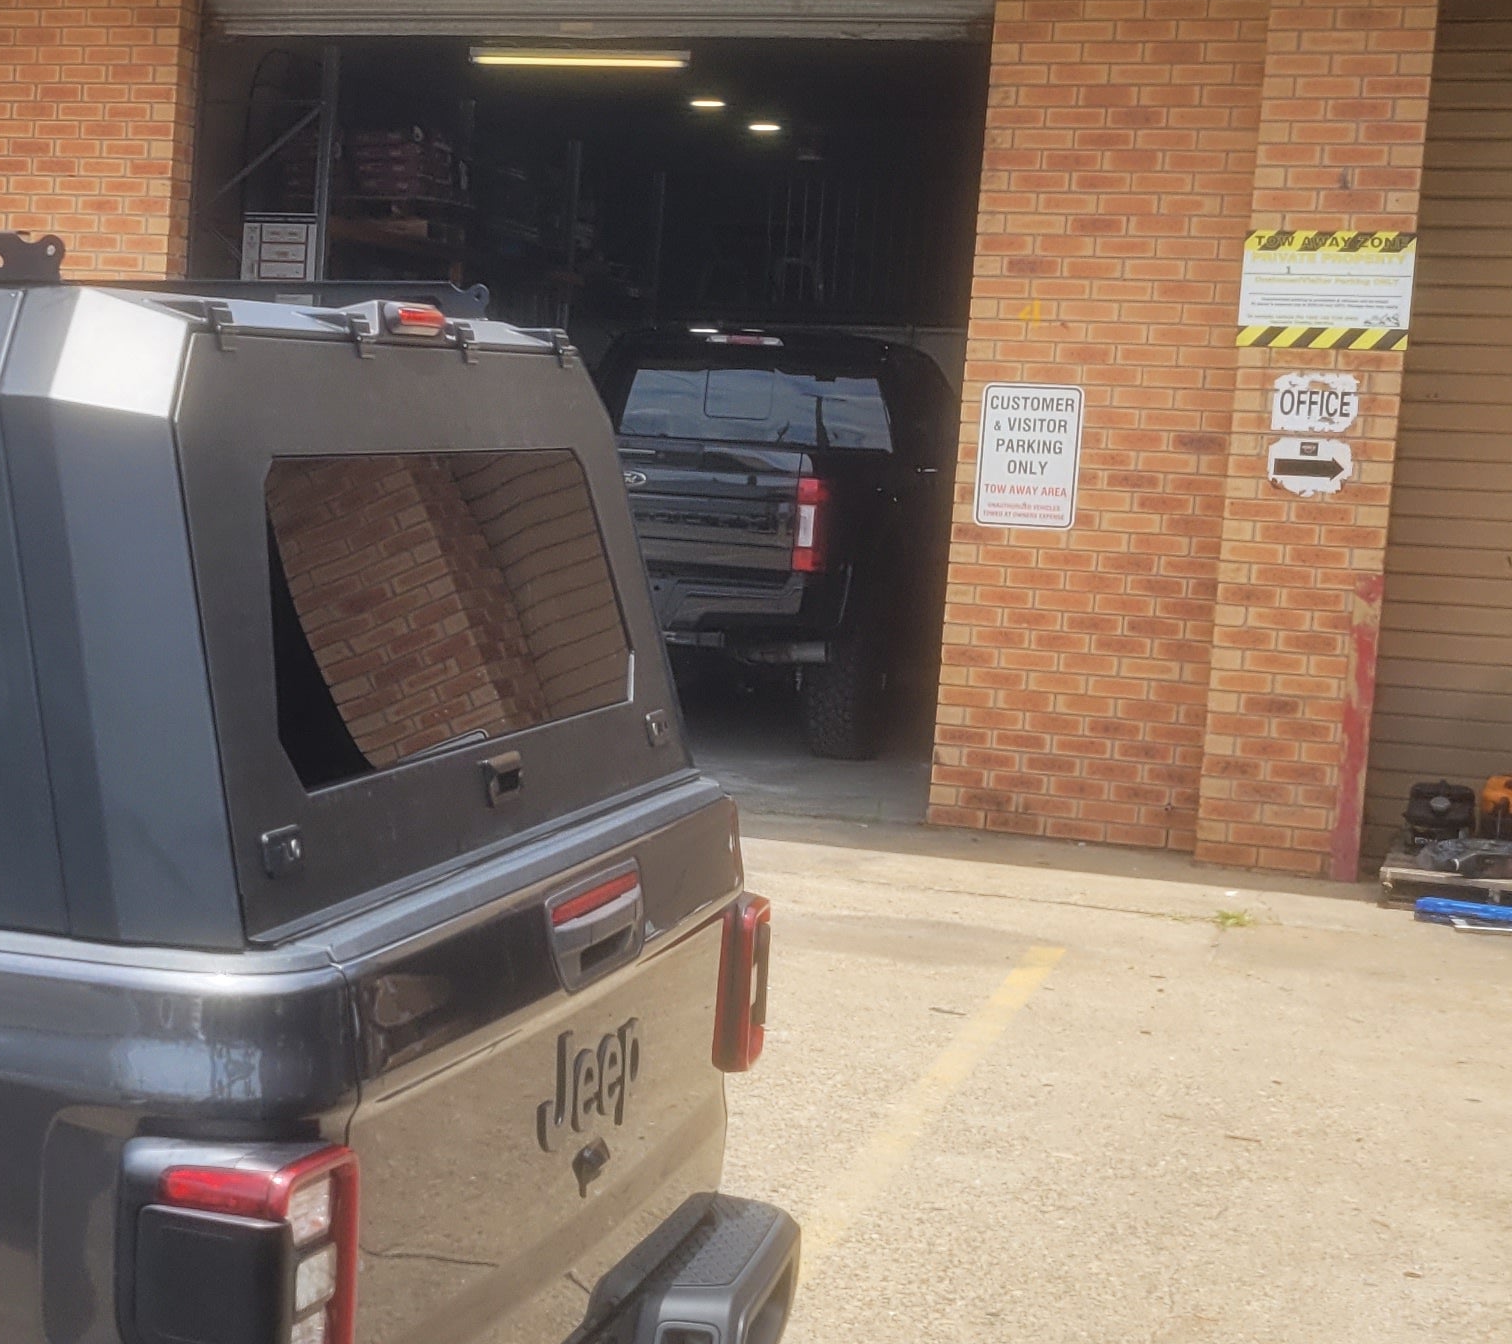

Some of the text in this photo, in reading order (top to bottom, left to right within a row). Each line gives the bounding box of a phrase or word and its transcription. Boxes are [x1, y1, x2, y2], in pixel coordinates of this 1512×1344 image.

[1255, 234, 1410, 250] TOW AWAY ZONE
[1251, 252, 1406, 266] PRIVATE PROPERTY
[990, 395, 1075, 413] CUSTOMER
[1279, 389, 1352, 418] OFFICE
[993, 417, 1068, 434] & VISITOR
[995, 439, 1063, 455] PARKING
[1007, 459, 1048, 476] ONLY
[984, 483, 1068, 498] TOW AWAY AREA
[536, 1016, 640, 1154] Jeep
